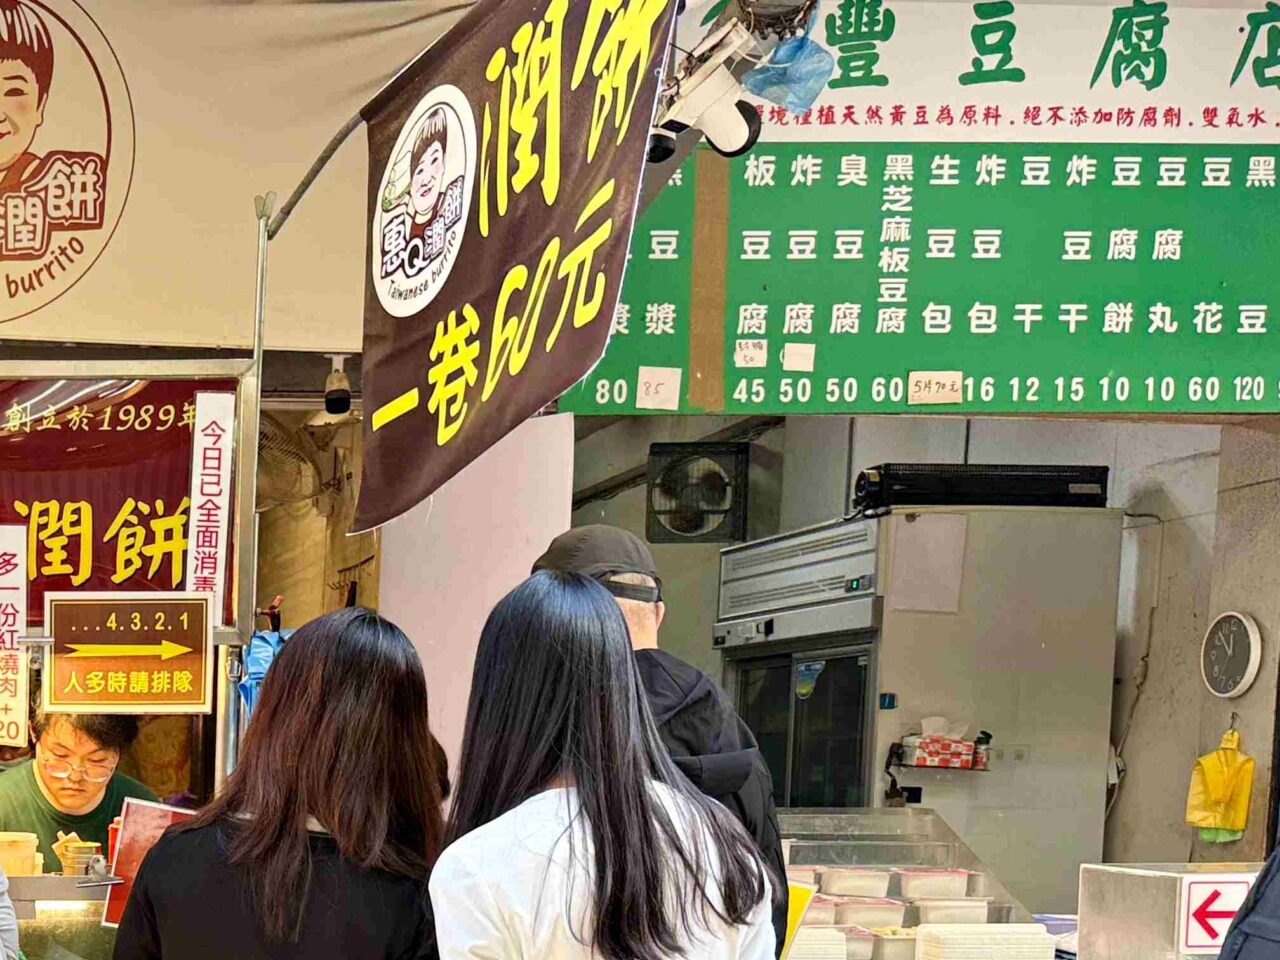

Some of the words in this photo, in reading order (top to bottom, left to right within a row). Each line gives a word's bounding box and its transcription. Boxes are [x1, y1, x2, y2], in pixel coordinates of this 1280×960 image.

[6, 236, 85, 300] burrito
[372, 179, 615, 446] 一卷60元
[390, 279, 429, 300] Taiwanese
[431, 230, 456, 284] burrito
[737, 154, 776, 335] 板豆腐
[783, 154, 822, 335] 炸豆腐
[830, 154, 869, 335] 臭豆腐
[876, 154, 915, 334] 黑芝麻板豆腐
[922, 154, 961, 334] 生豆包
[968, 154, 1006, 334] 炸豆包
[1013, 156, 1052, 334] 豆干
[1058, 155, 1097, 334] 炸豆干
[1103, 156, 1142, 334] 豆腐餅
[1148, 156, 1188, 334] 豆腐丸
[1193, 156, 1232, 334] 豆花
[3, 401, 196, 433] 創立於1989年
[595, 377, 628, 403] 80
[732, 377, 765, 403] 45
[779, 377, 811, 403] 50
[825, 377, 858, 403] 50
[871, 377, 904, 403] 60
[964, 377, 995, 402] 16
[1009, 377, 1039, 402] 12
[1054, 377, 1085, 402] 15
[1099, 377, 1130, 402] 10
[1144, 377, 1175, 402] 10
[1188, 377, 1220, 402] 60
[1233, 377, 1265, 402] 120
[63, 670, 194, 694] 人多時請排隊
